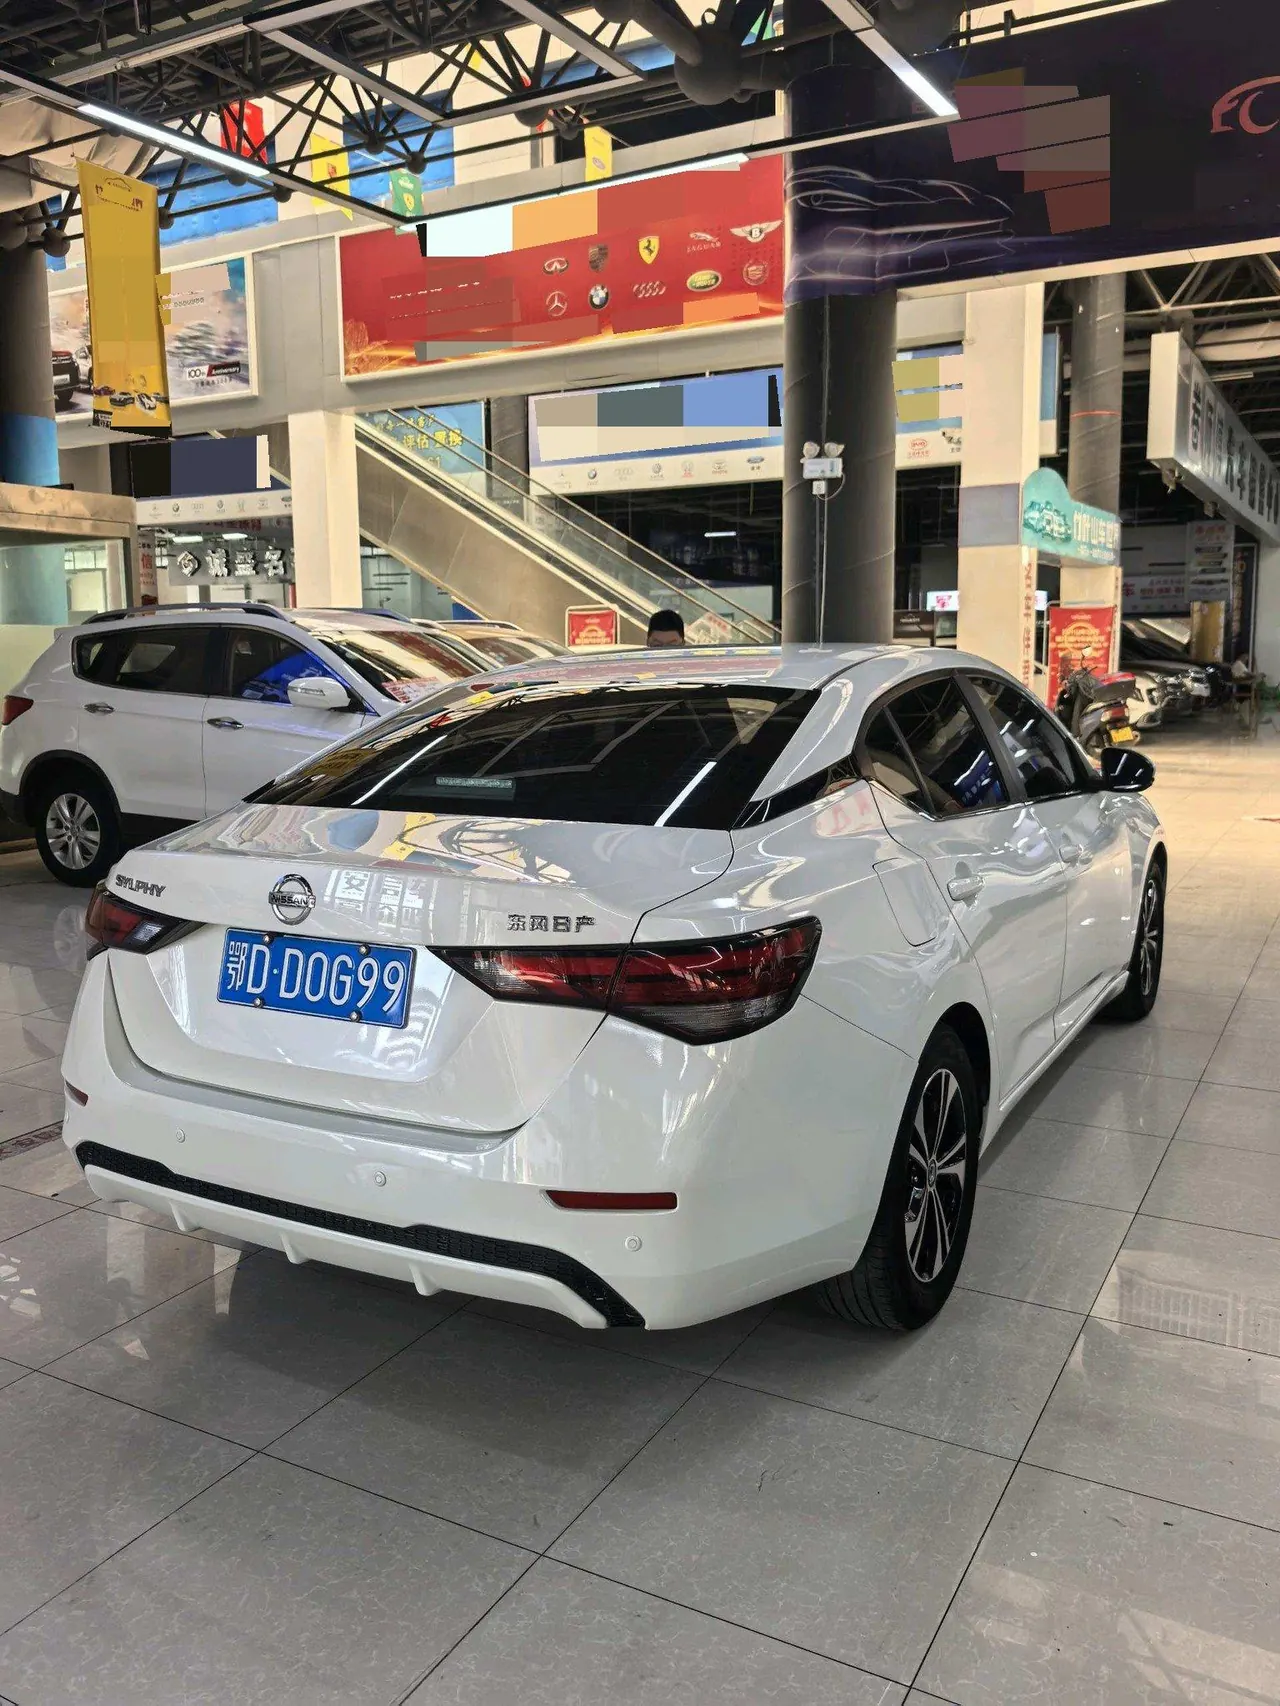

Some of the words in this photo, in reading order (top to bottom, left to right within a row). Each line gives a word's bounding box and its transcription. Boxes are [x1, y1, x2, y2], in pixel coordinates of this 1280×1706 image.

[115, 874, 166, 898] SYLPHY
[270, 892, 311, 908] NISSAN
[507, 913, 597, 934] 东风日产
